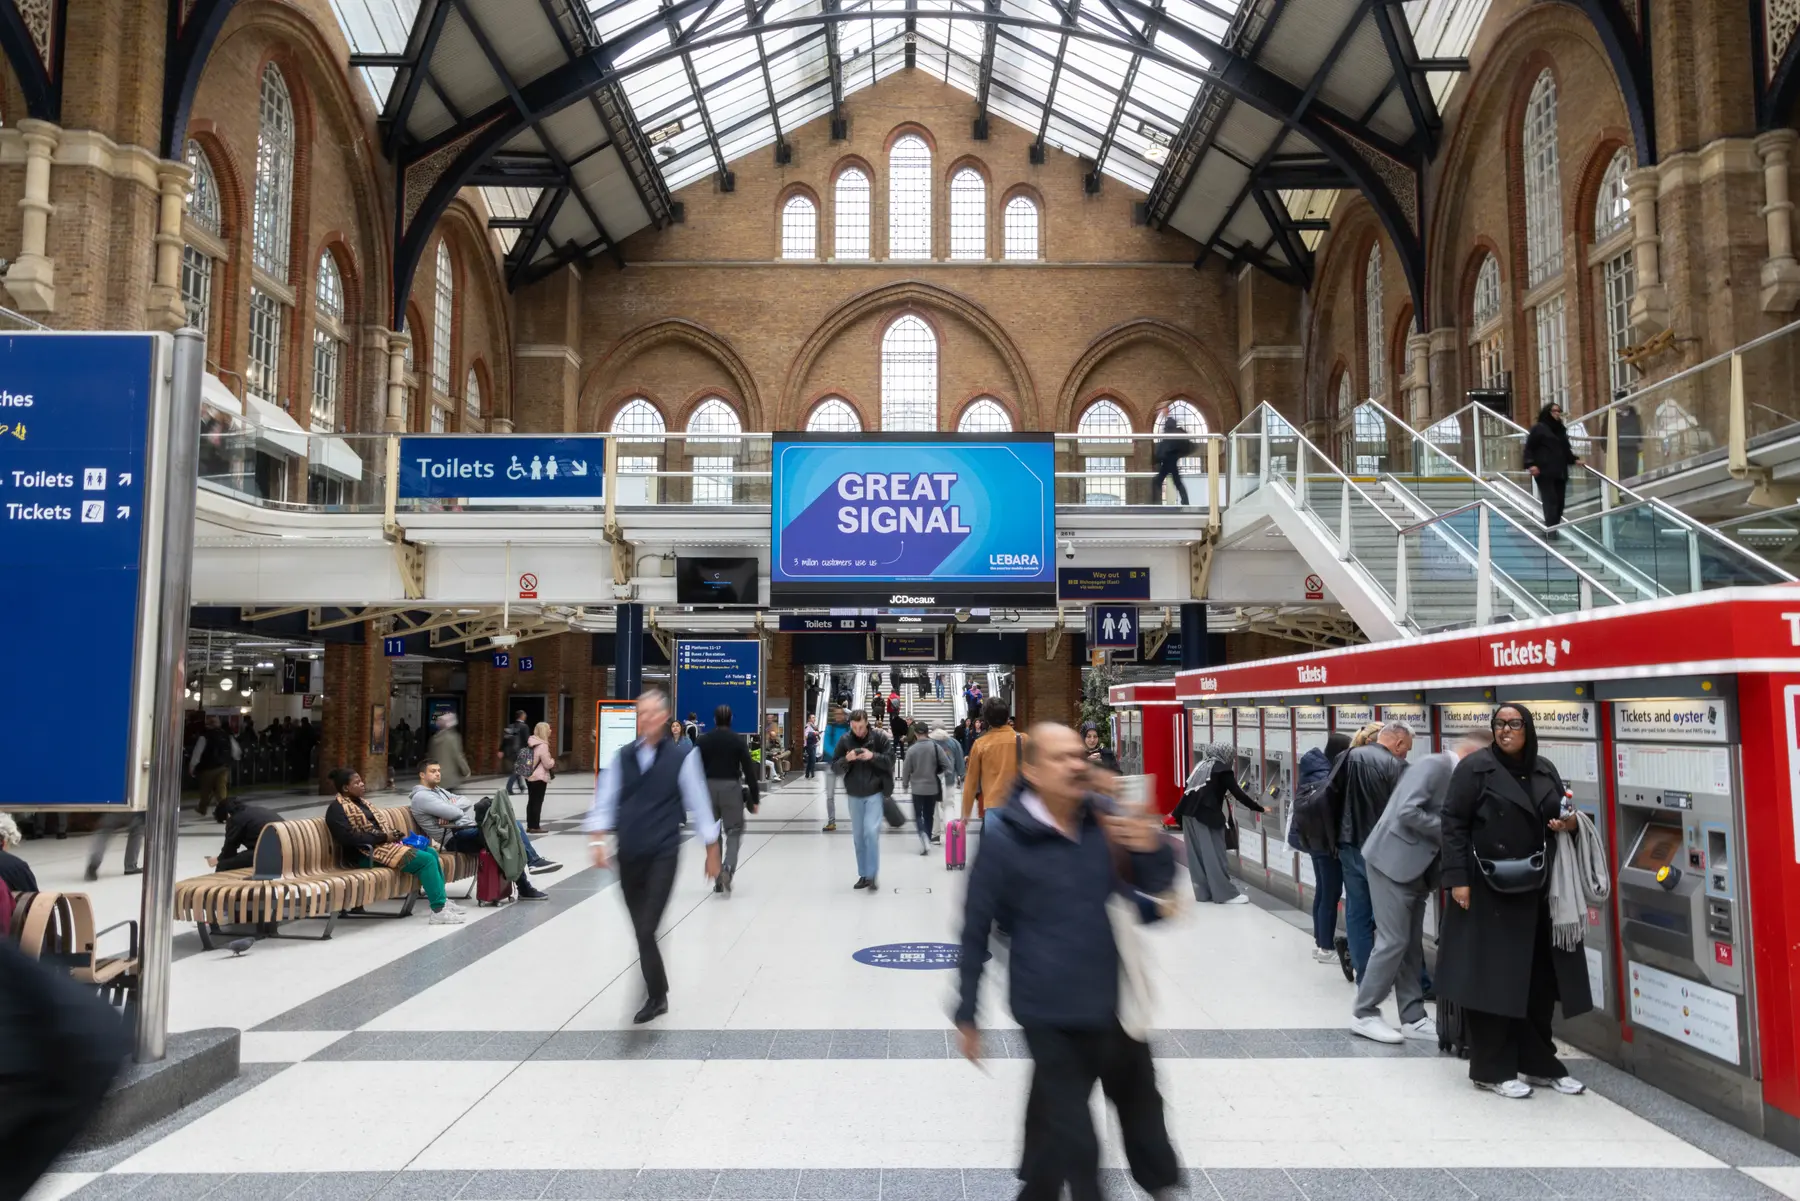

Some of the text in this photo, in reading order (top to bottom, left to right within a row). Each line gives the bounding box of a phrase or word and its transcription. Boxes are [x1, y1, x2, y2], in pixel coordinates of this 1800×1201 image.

[0, 390, 34, 407] hes
[416, 457, 495, 479] Toilets
[11, 470, 74, 488] Toilets
[838, 473, 957, 501] GREAT
[6, 502, 72, 520] Tickets
[837, 506, 970, 534] SIGNAL
[793, 557, 799, 567] 3
[821, 558, 853, 567] customers
[854, 559, 867, 567] use
[869, 559, 878, 567] us
[989, 554, 1039, 565] LEBARA
[1092, 571, 1107, 580] Way
[889, 595, 935, 604] JCDecaux
[804, 619, 833, 629] Toilets
[387, 640, 402, 653] 11
[1490, 638, 1543, 668] Tickets
[495, 655, 508, 667] 12
[520, 658, 533, 670] 13
[284, 662, 295, 680] 12
[1296, 664, 1322, 684] Tickets
[1200, 677, 1214, 691] Tickets
[1338, 710, 1350, 720] Tickets
[1356, 711, 1369, 721] oyster
[1383, 710, 1422, 723] Tickets and oyster
[1443, 710, 1490, 723] Tickets and oyster
[1543, 710, 1556, 721] and
[1557, 710, 1580, 723] oyster
[1621, 708, 1704, 726] Tickets and oyster
[1719, 947, 1728, 958] 14
